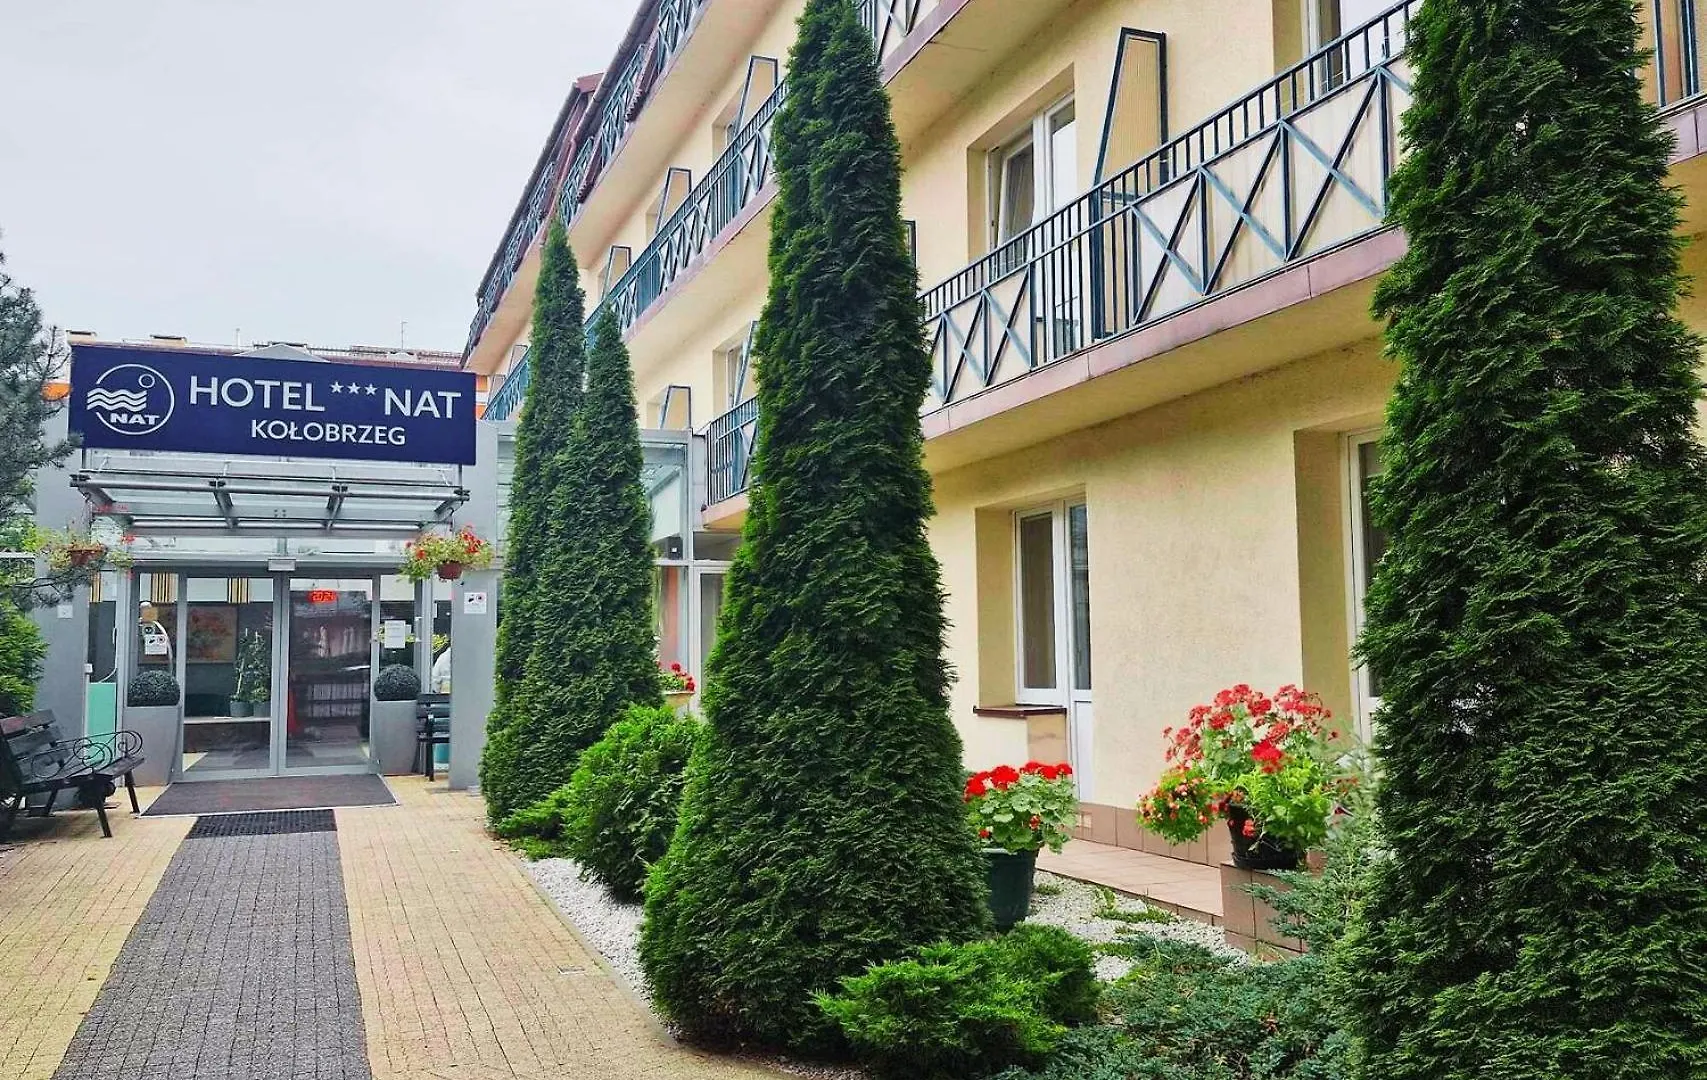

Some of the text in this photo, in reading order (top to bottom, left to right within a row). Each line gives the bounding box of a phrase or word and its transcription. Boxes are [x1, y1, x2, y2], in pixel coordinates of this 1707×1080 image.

[189, 375, 462, 419] HOTEL NAT
[110, 412, 160, 426] NAT
[251, 418, 406, 446] KOŁOBRZEG
